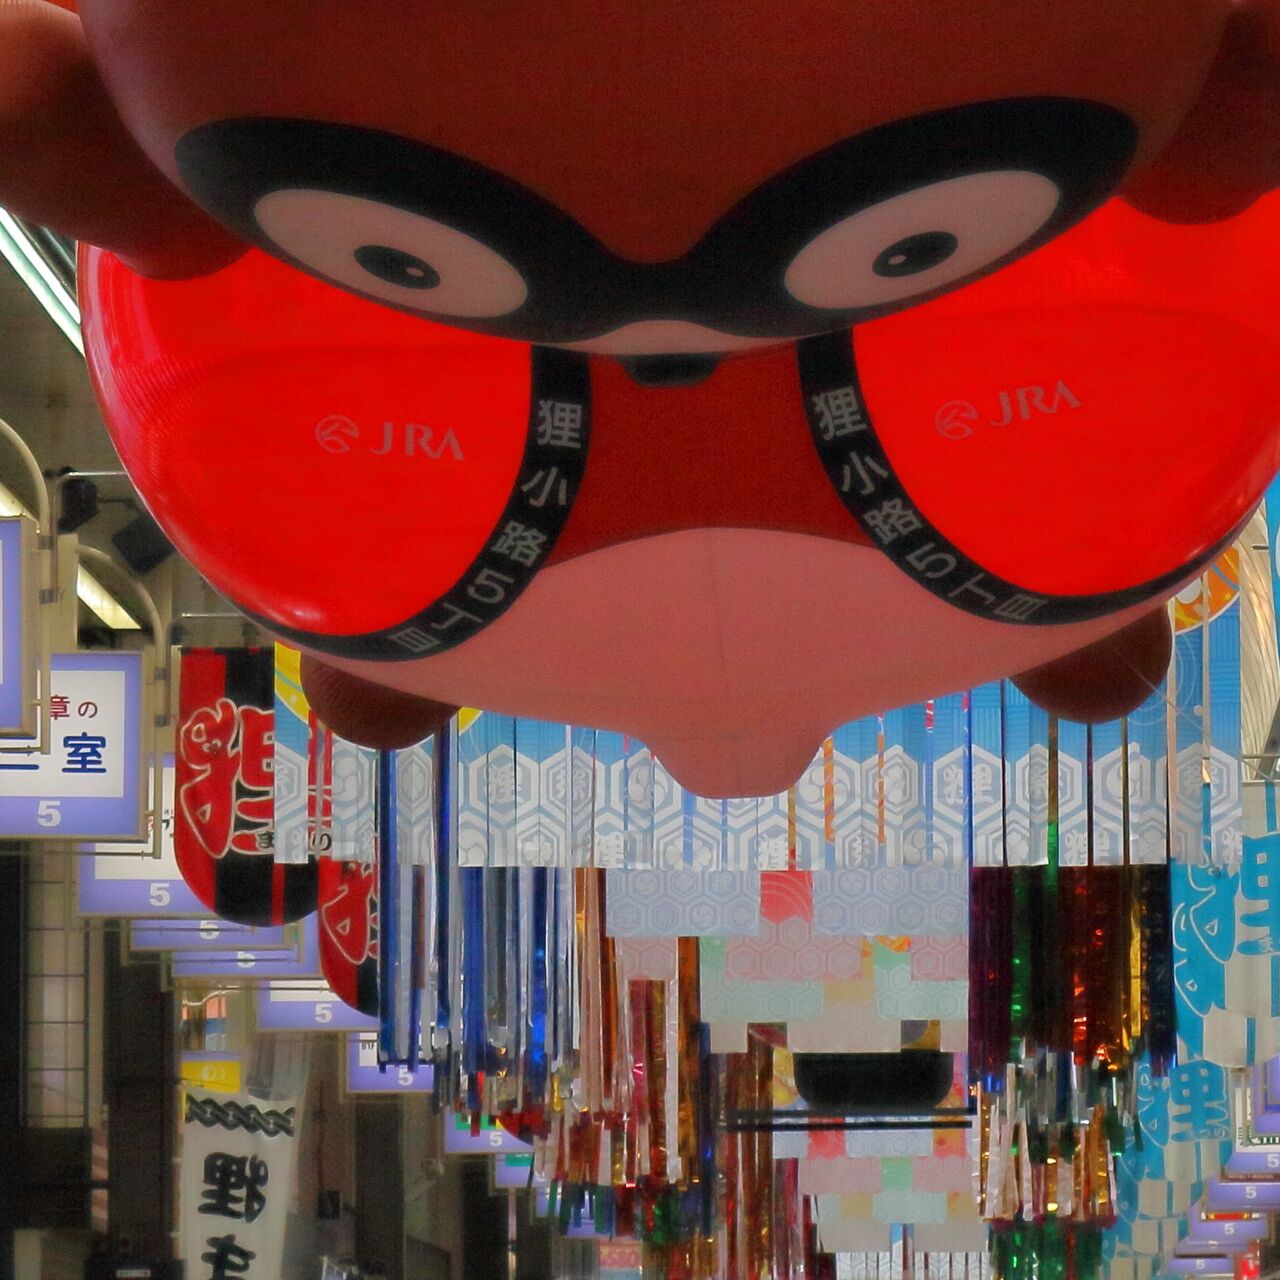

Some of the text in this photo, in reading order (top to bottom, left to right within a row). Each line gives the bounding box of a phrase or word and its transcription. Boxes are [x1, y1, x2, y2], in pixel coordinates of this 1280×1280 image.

[991, 380, 1081, 427] JRA
[370, 421, 465, 462] JRA
[37, 800, 61, 827] 5
[149, 883, 170, 906] 5
[200, 920, 220, 940] 5
[237, 951, 256, 968] 5
[315, 1003, 333, 1023] 5
[398, 1067, 414, 1086] 5
[489, 1132, 503, 1147] 5
[1267, 1154, 1280, 1168] 5
[1245, 1186, 1257, 1199] 5
[1224, 1223, 1234, 1235] 5
[1195, 1259, 1206, 1269] 5
